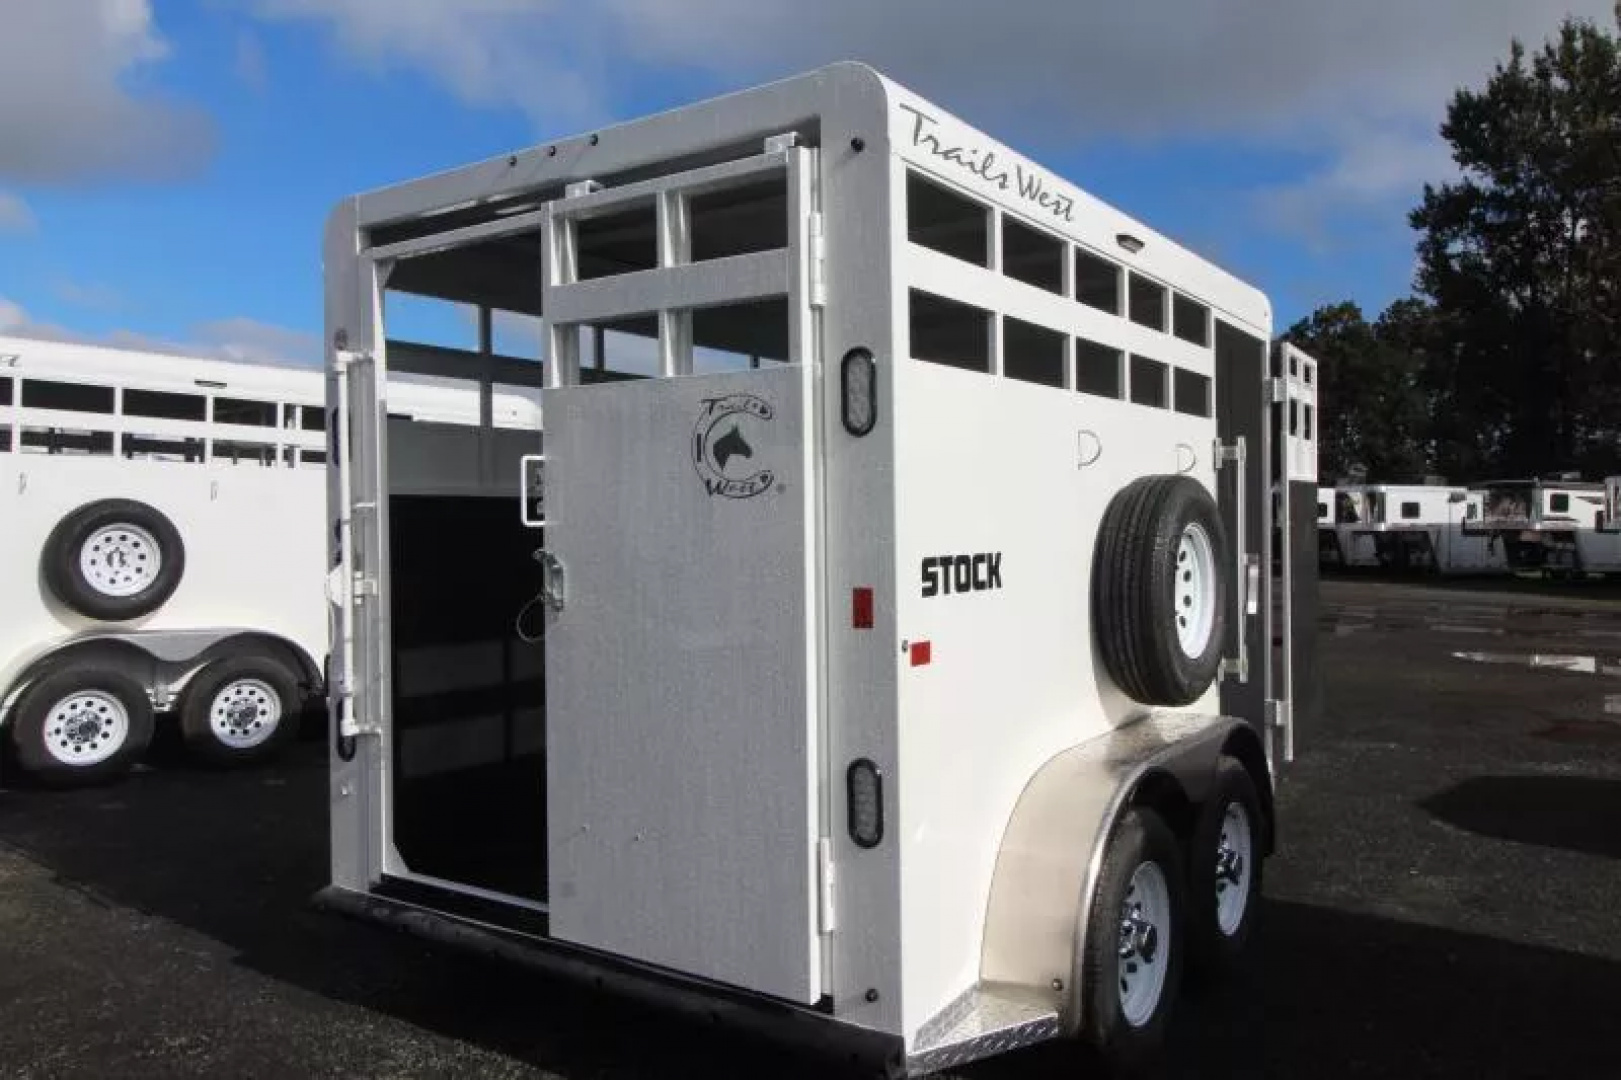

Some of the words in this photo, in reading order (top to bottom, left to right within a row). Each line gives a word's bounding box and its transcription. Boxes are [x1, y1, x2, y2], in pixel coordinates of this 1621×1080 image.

[899, 102, 1009, 190] Trails
[1016, 163, 1075, 222] West
[921, 551, 1002, 598] STOCK
